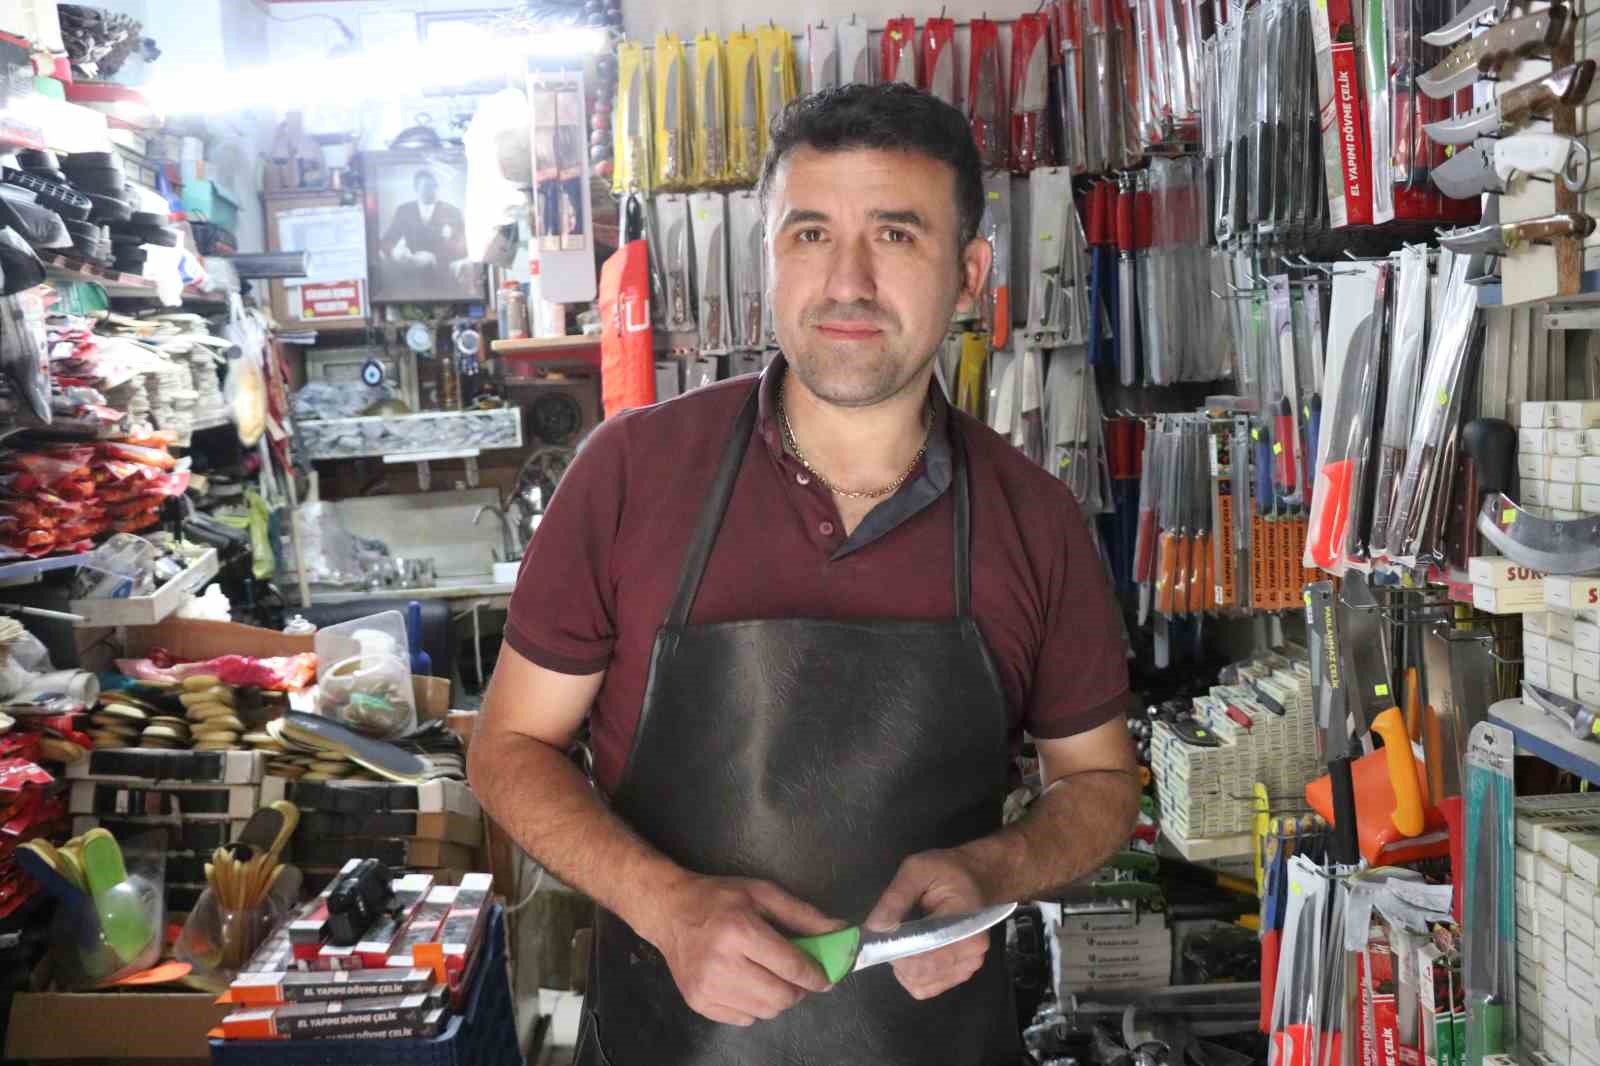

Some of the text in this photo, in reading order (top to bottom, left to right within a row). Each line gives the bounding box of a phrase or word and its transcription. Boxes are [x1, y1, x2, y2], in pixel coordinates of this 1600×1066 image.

[1338, 71, 1360, 197] EL YAPIMI DÖVME ÇELİK
[1383, 1028, 1396, 1055] ÇELİK
